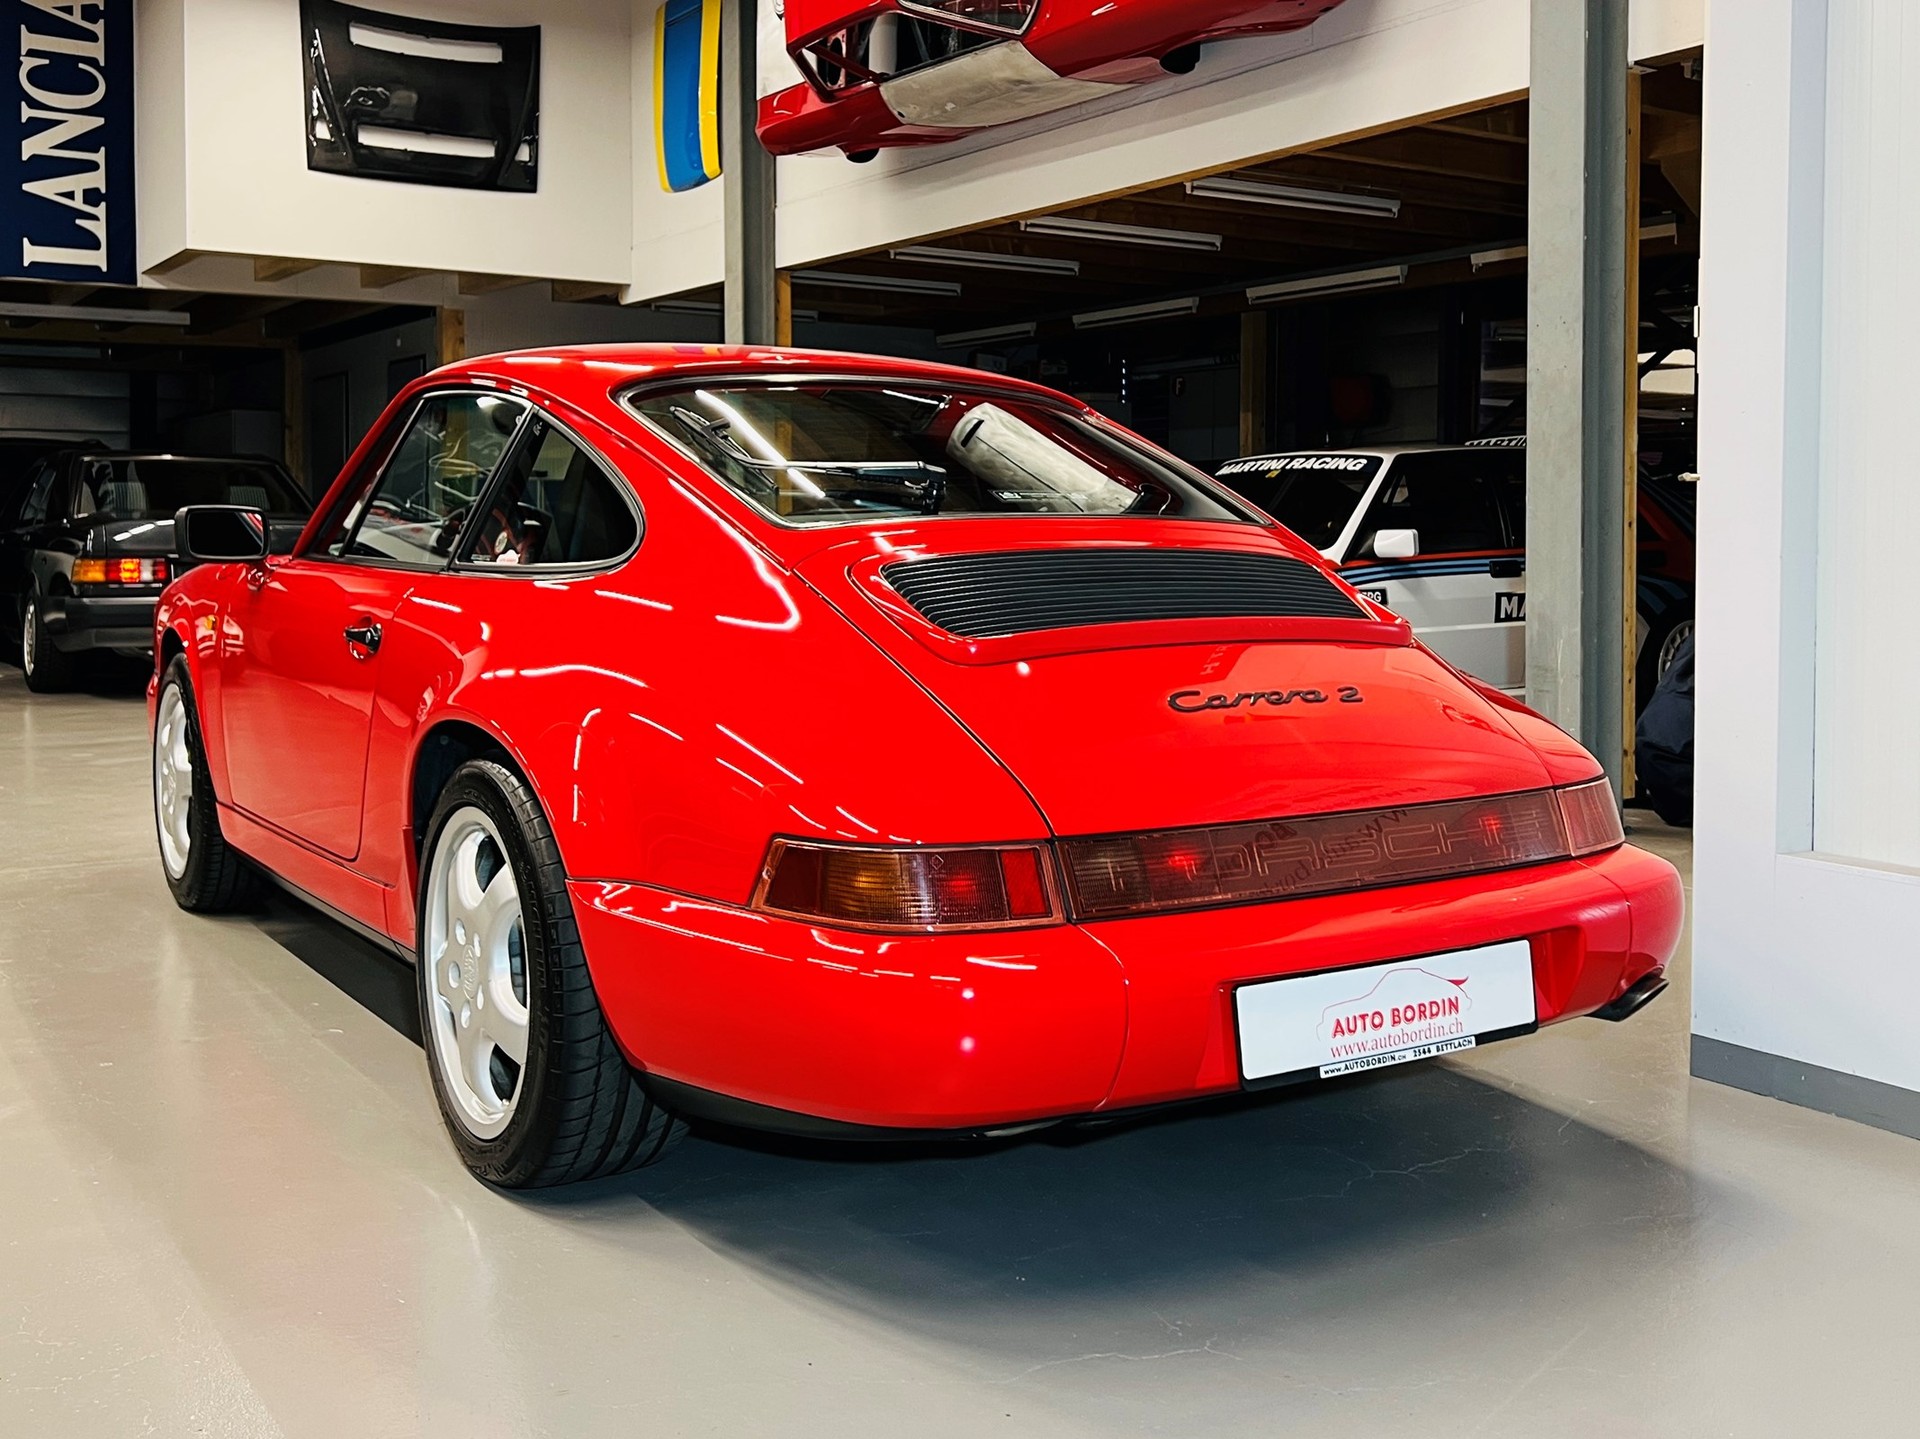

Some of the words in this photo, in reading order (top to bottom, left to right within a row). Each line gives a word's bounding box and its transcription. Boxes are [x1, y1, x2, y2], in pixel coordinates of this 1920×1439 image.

[1215, 457, 1291, 477] MARTINI
[1285, 457, 1368, 472] RACING
[1168, 689, 1329, 713] Carrera
[1337, 686, 1364, 703] 2
[1331, 1010, 1384, 1039] AUTO
[1390, 995, 1460, 1028] BORDIN
[1330, 1017, 1464, 1059] www.autobordin.ch
[1436, 1039, 1473, 1053] BETTLACH
